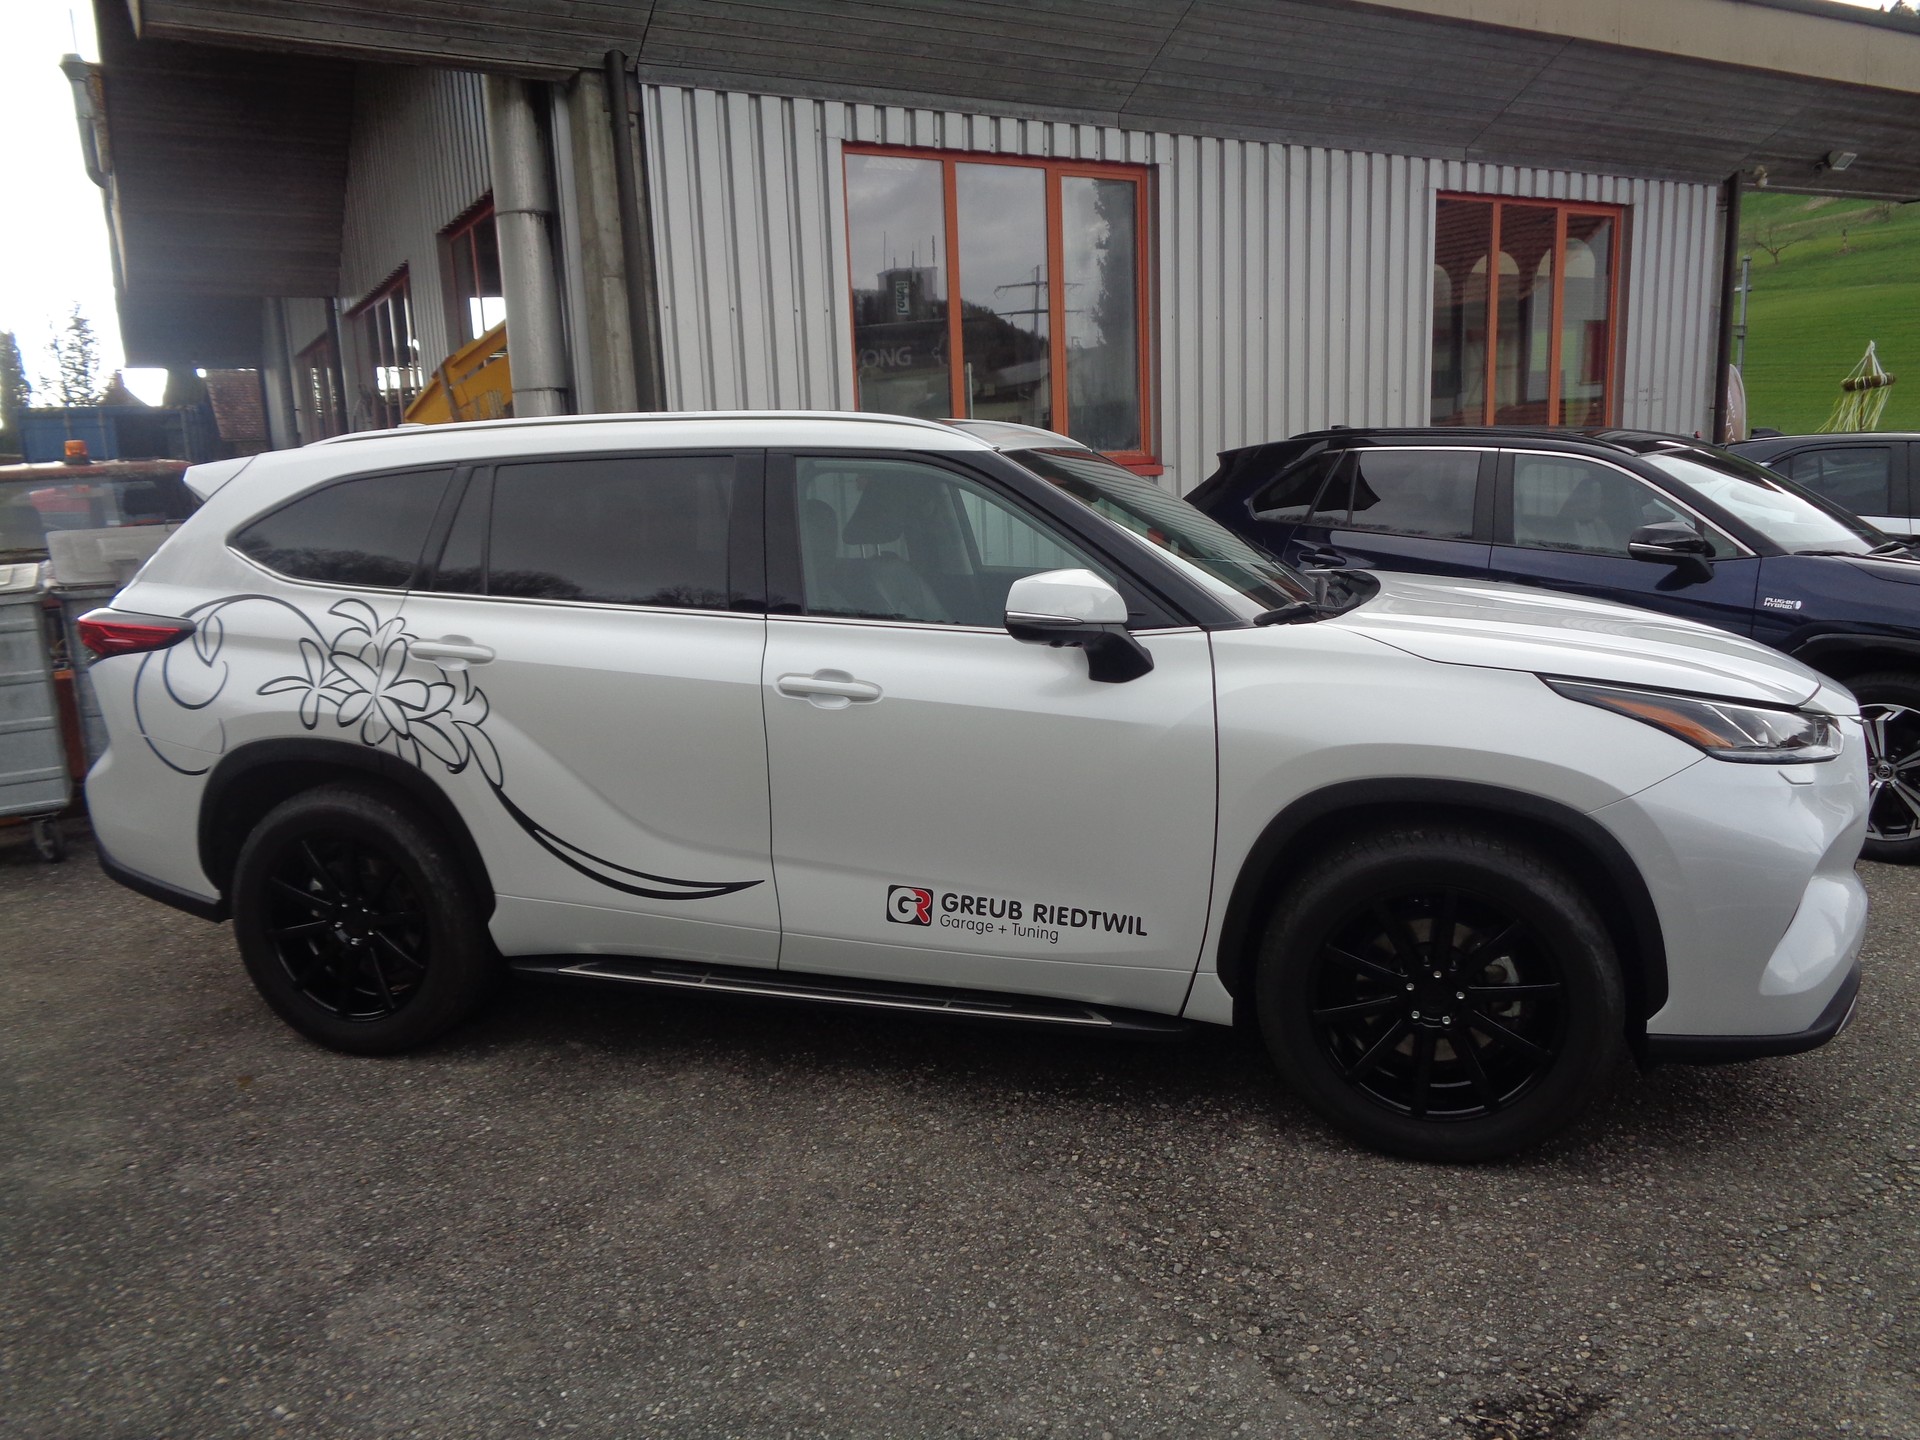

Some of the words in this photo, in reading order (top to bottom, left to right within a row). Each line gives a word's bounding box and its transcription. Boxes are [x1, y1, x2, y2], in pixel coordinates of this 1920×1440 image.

[887, 886, 932, 926] GR
[941, 893, 1023, 920] GREUB
[1032, 903, 1148, 937] RIEDTWIL
[939, 914, 994, 935] Garage
[998, 924, 1008, 935] +
[1012, 922, 1060, 944] Tuning
